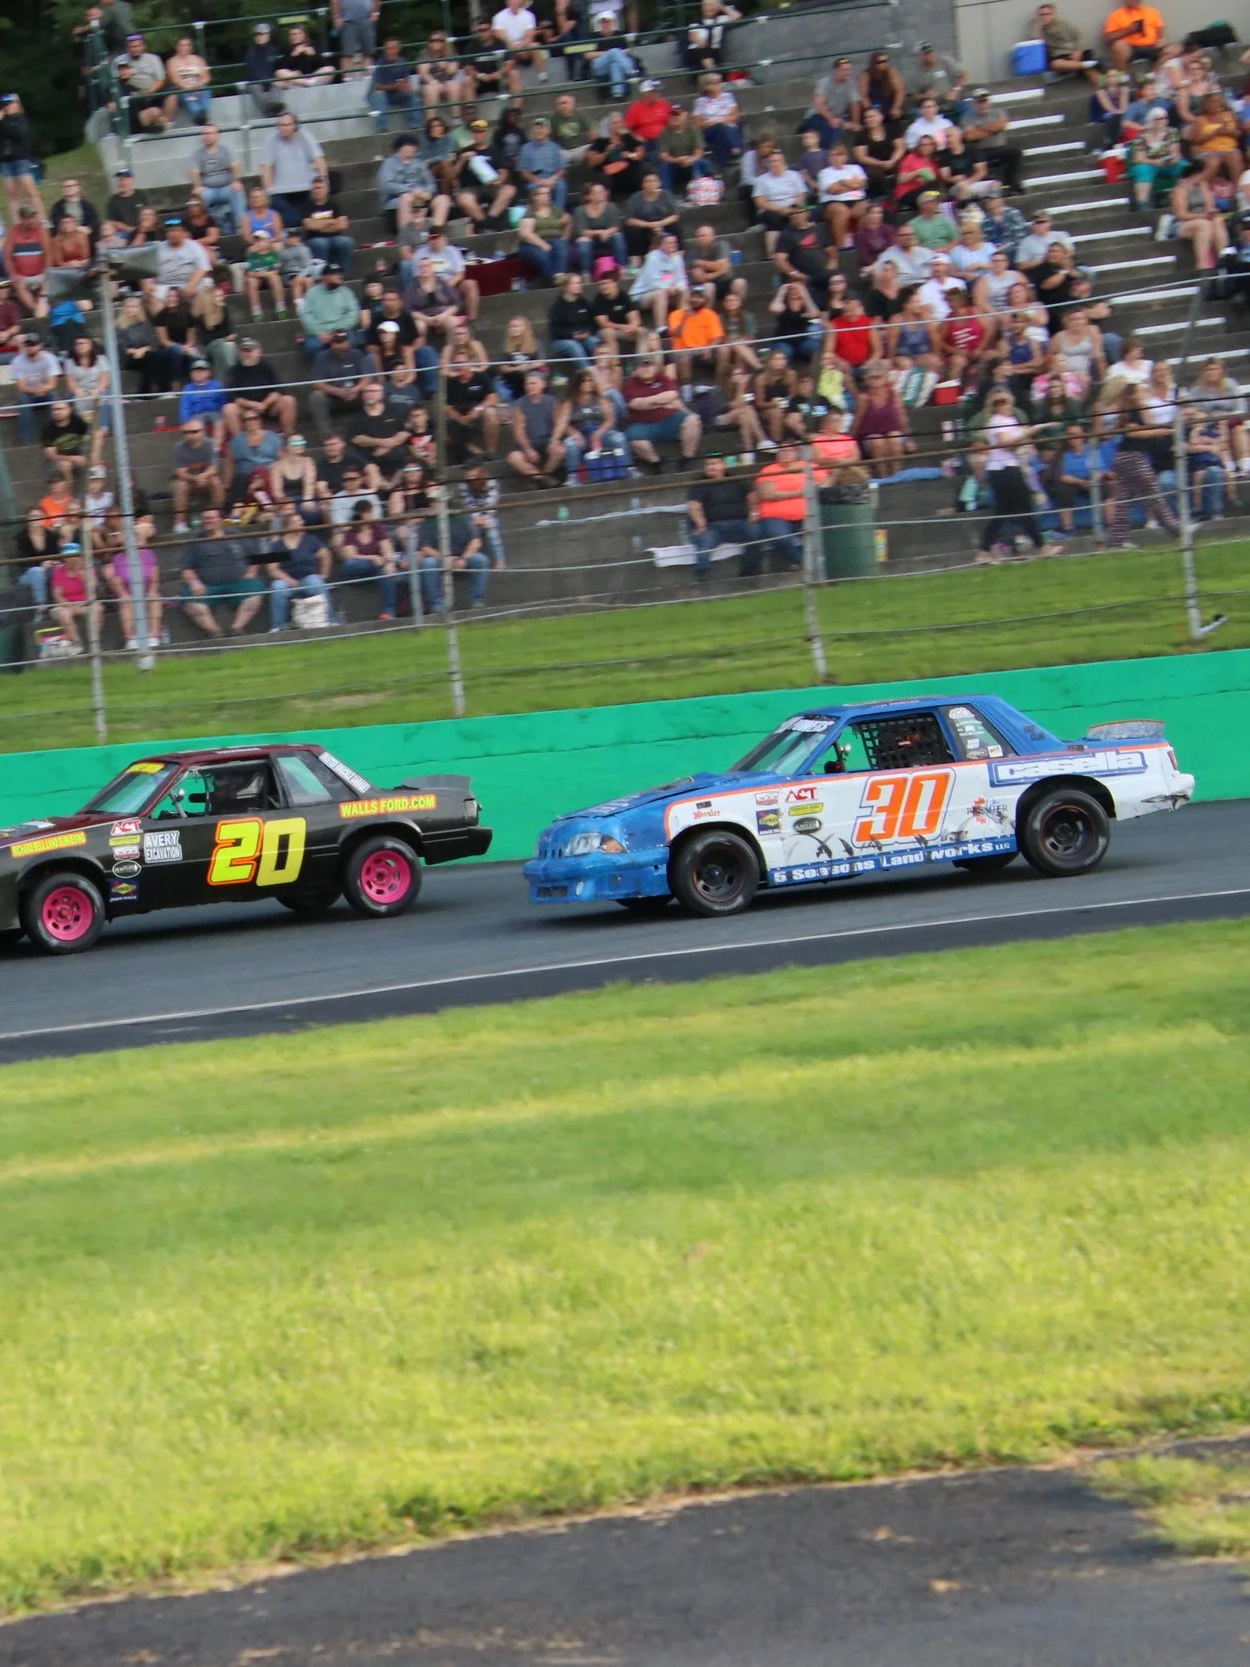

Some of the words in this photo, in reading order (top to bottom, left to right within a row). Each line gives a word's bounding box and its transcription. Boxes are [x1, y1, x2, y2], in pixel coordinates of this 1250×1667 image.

[786, 787, 817, 802] ACT
[341, 801, 378, 817] WALLS
[381, 796, 435, 812] FORD.COM
[854, 769, 954, 845] 30
[111, 819, 141, 834] ACT
[146, 832, 177, 847] AVERY
[147, 846, 181, 860] EXCAVATION
[207, 817, 306, 886] 20
